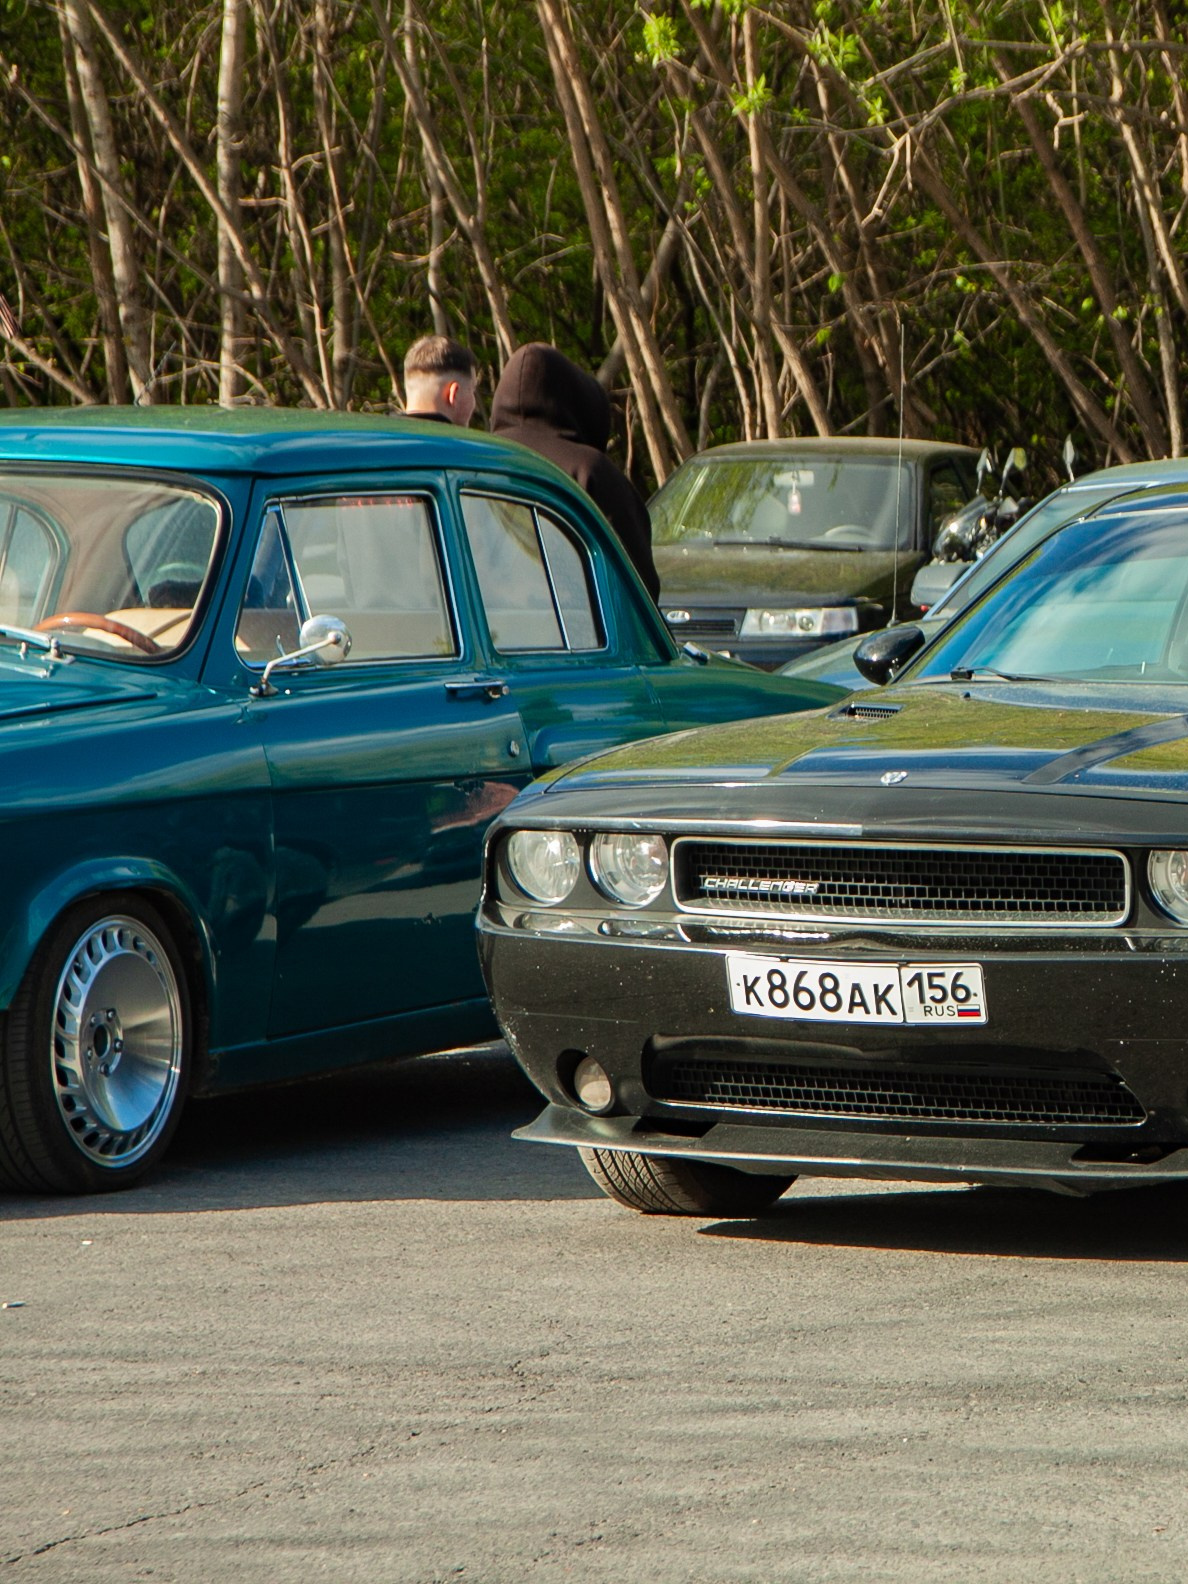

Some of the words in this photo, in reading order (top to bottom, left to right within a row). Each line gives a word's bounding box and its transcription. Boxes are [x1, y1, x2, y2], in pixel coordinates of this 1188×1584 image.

[704, 877, 819, 894] CHALLENGER
[742, 968, 898, 1016] К868АК
[906, 971, 972, 1004] 156
[923, 1005, 956, 1017] RUS
